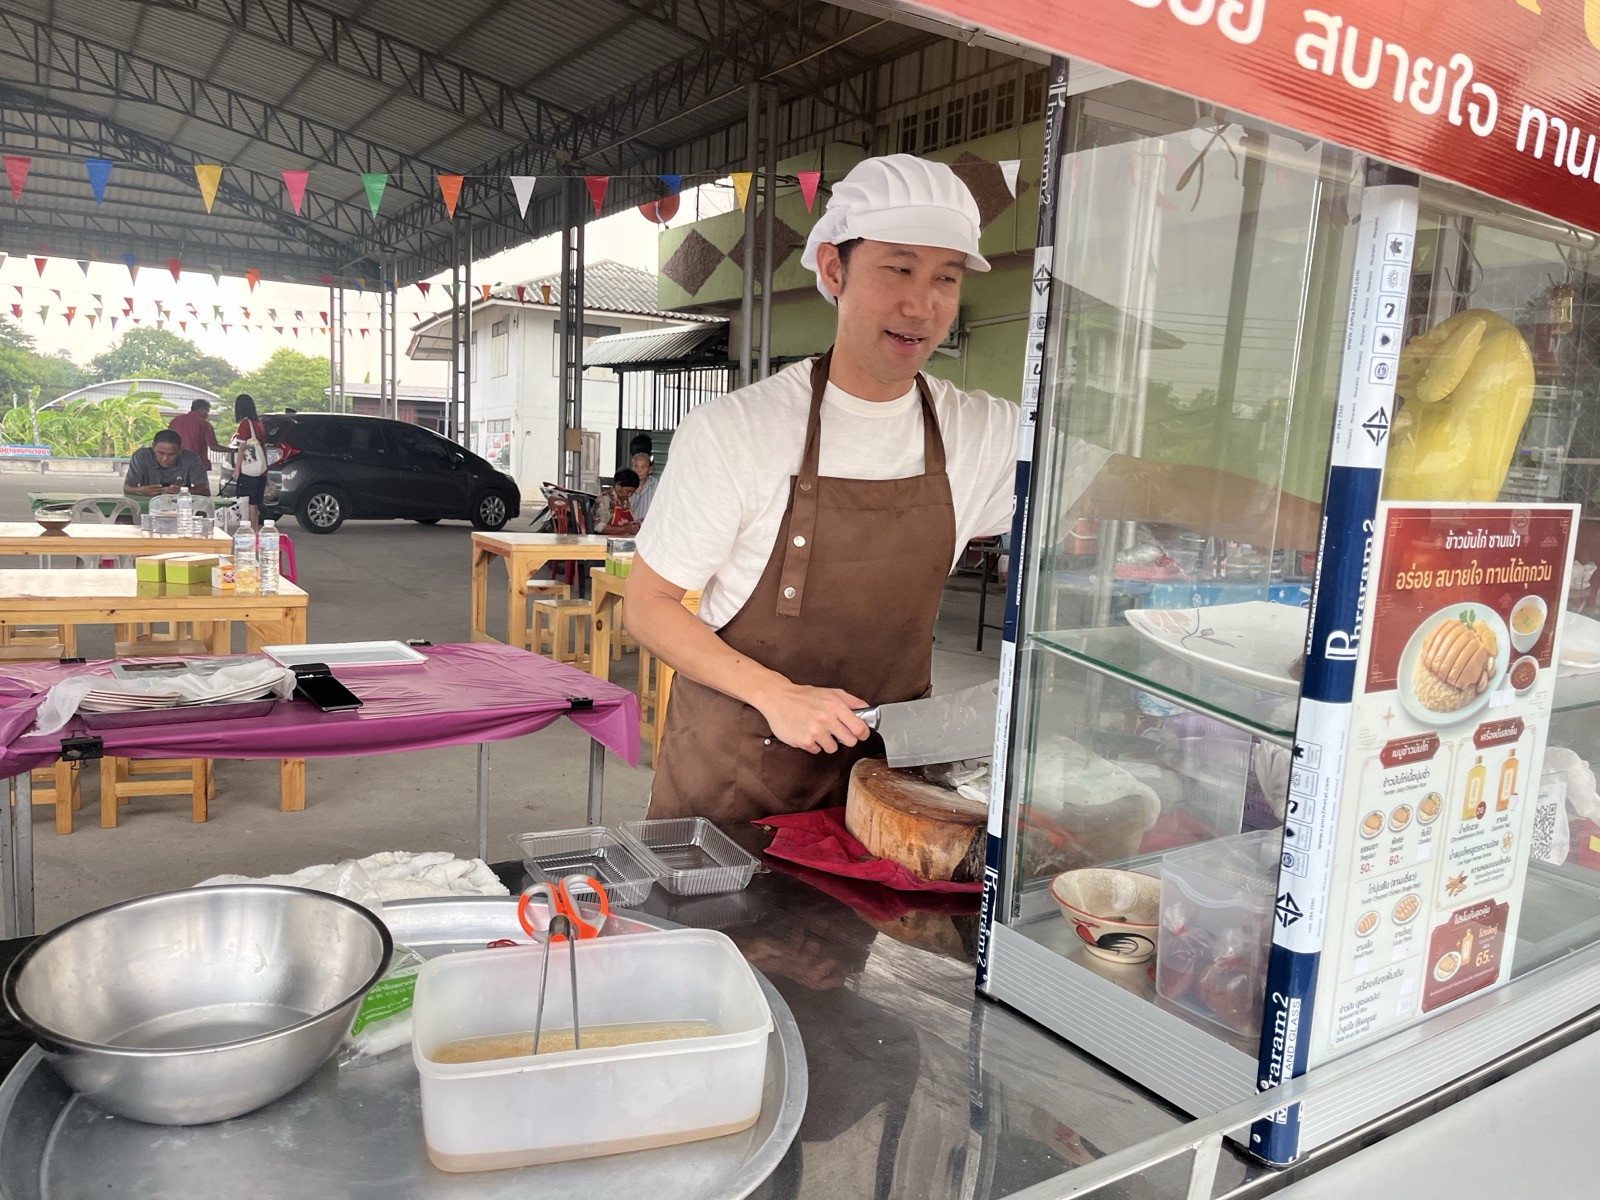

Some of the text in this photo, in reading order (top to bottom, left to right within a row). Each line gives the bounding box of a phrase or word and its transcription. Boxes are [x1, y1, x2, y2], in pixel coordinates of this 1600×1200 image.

[1294, 9, 1499, 138] สบายใจ
[1515, 104, 1600, 185] ทาน
[1345, 269, 1361, 350] www.rama2metal.com
[1445, 529, 1488, 550] ข้าวมันไก่
[1396, 558, 1552, 590] อร่อย สบายใจ ทานได้ทุกวัน
[1317, 777, 1330, 850] www.rama2metal.com
[1360, 863, 1374, 874] 50.-
[1389, 855, 1403, 866] 60.-
[1475, 949, 1494, 967] 65.-
[1288, 1000, 1301, 1042] GLASS
[1285, 1046, 1295, 1070] AND
